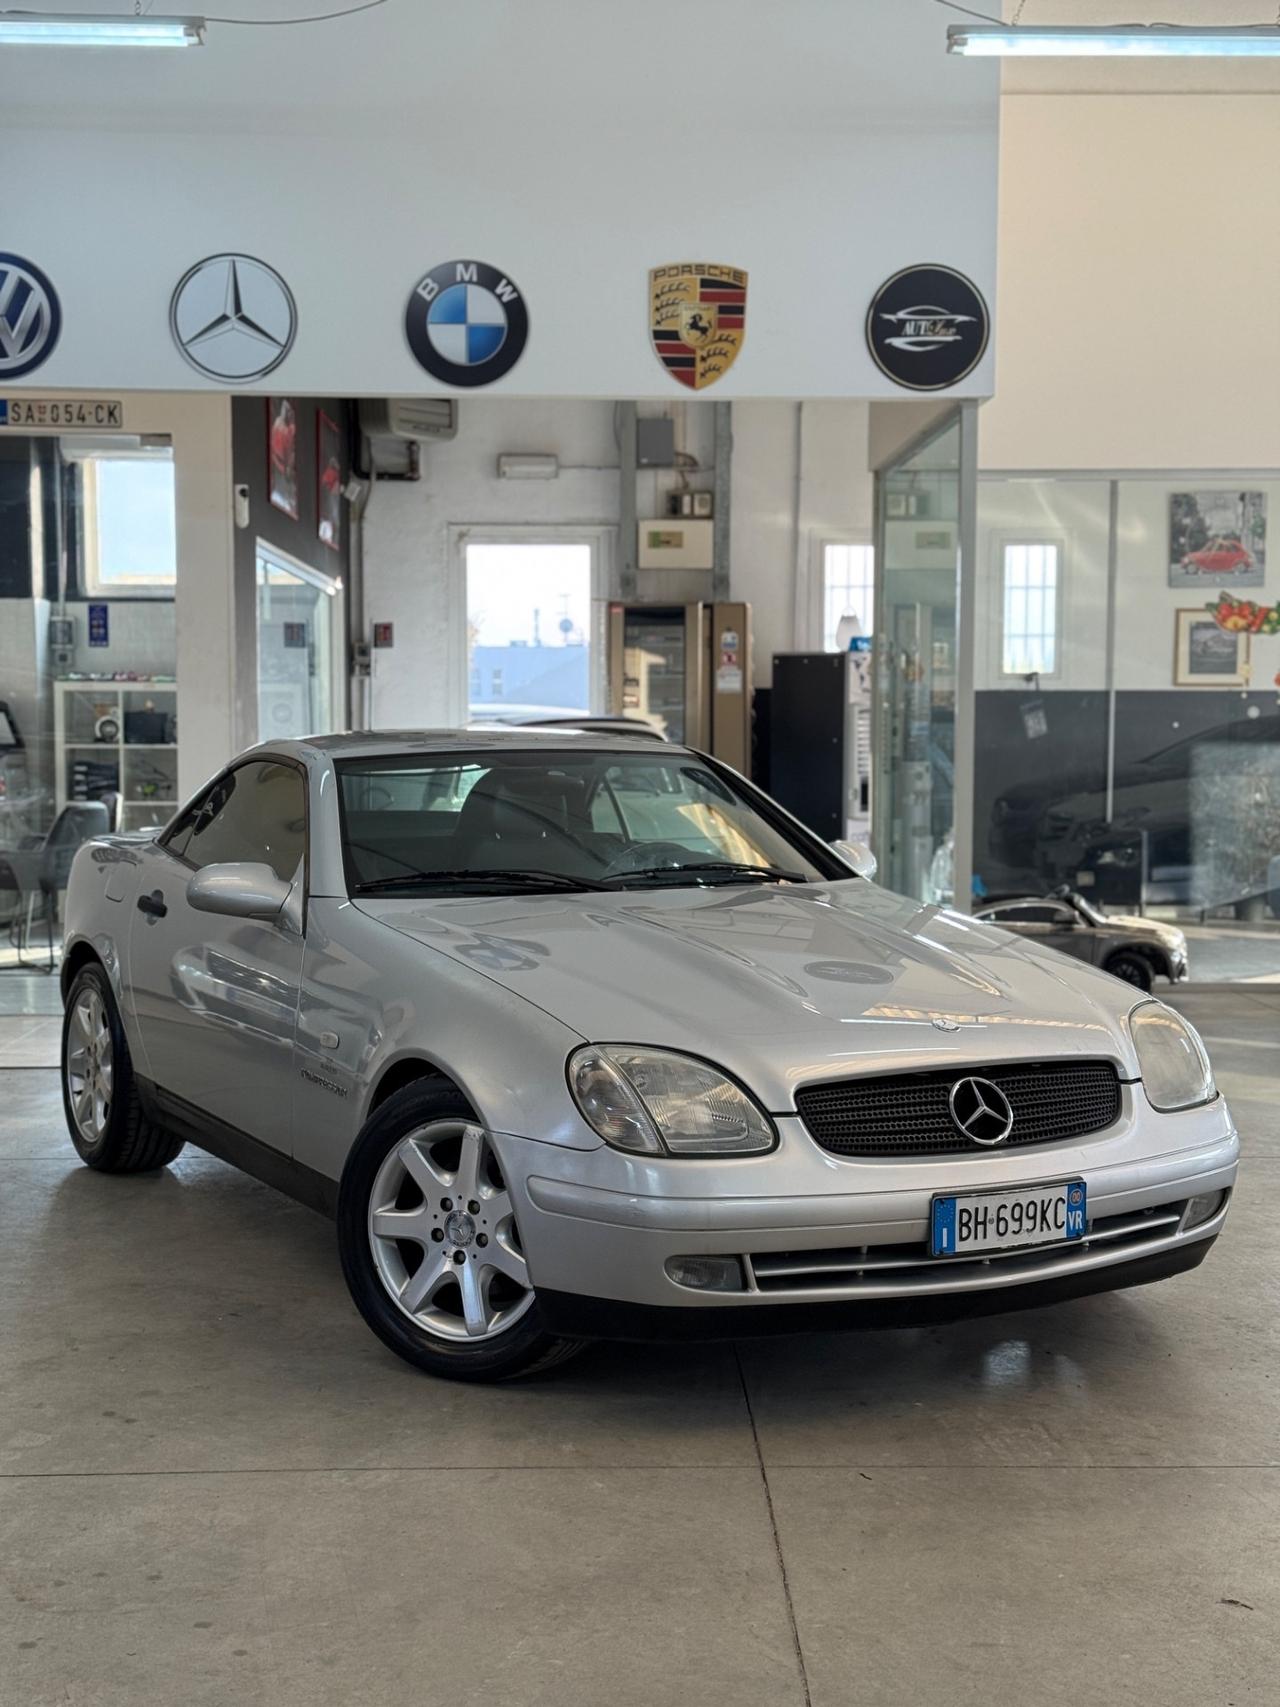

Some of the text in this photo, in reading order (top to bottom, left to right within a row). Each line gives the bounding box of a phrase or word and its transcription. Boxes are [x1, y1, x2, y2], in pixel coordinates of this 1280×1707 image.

[416, 263, 519, 303] BMW
[653, 264, 746, 285] PORSCHE
[11, 402, 35, 423] SA
[1068, 1210, 1083, 1231] VR
